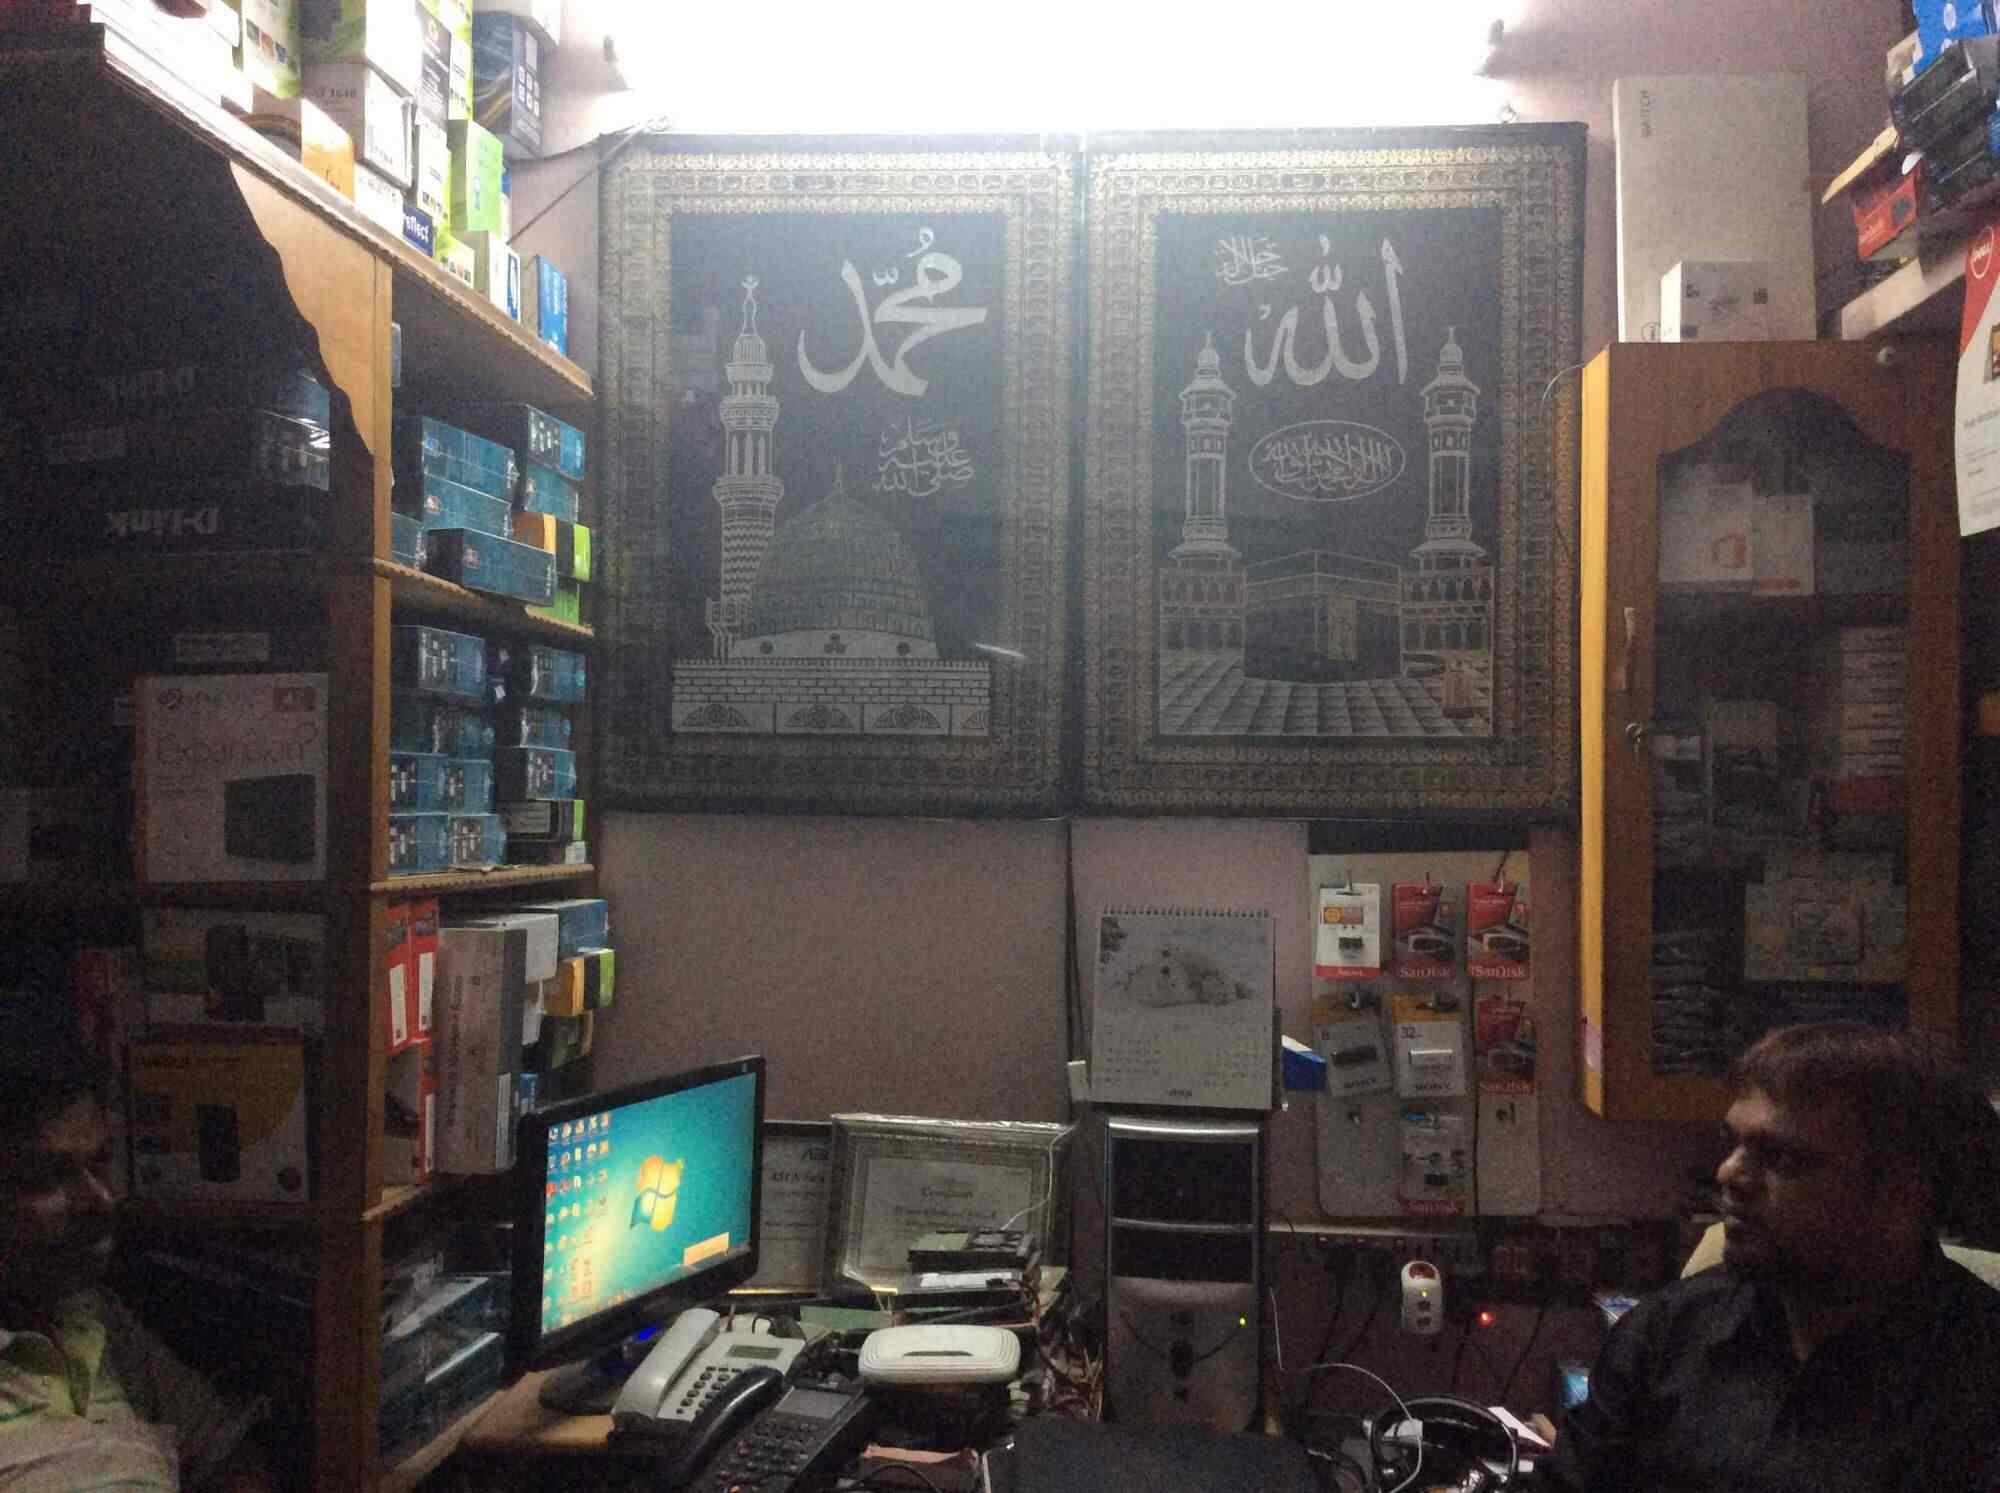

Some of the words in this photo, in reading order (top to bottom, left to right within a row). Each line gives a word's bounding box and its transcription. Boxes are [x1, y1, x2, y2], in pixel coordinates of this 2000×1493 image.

[1244, 234, 1408, 386] الله
[1399, 966, 1451, 978] SanDisk
[1474, 966, 1526, 978] SanDisk
